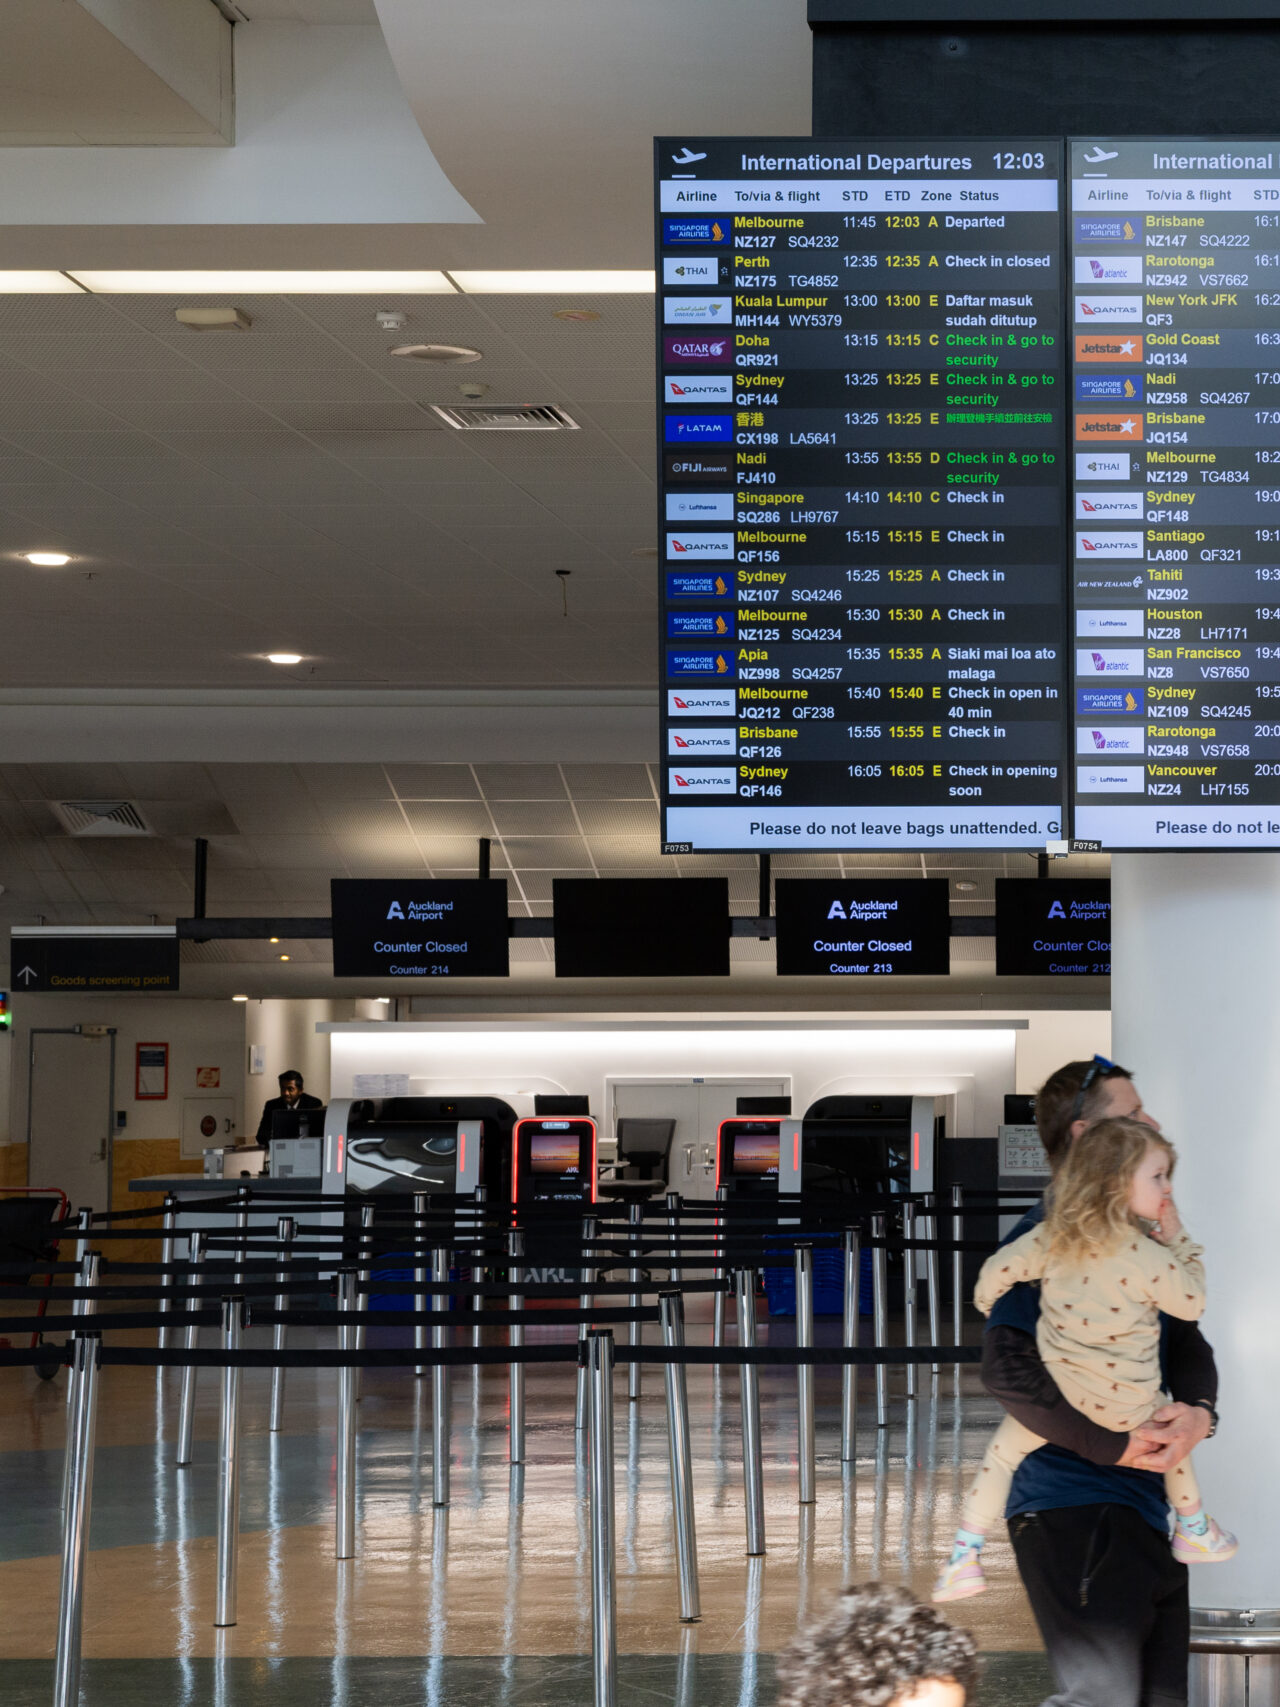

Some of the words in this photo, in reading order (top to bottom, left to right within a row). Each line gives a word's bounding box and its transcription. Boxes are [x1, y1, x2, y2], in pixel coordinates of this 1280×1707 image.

[742, 154, 861, 170] International
[868, 154, 972, 174] Departures
[993, 153, 1044, 169] 12:03
[1154, 154, 1272, 169] International
[677, 191, 717, 201] Airline
[735, 191, 770, 201] To/via
[775, 191, 784, 201] &
[788, 191, 820, 203] flight
[843, 191, 868, 201] STD
[885, 191, 910, 201] ETD
[921, 191, 952, 200] Zone
[960, 191, 999, 200] Status
[735, 217, 804, 227] Melbourne
[844, 216, 876, 227] 11:45
[886, 216, 919, 227] 12:03
[928, 216, 938, 227] A
[946, 216, 1004, 230] Departed
[735, 236, 776, 247] NZ127
[789, 236, 838, 247] SQ4232
[736, 335, 769, 346] Doha
[844, 334, 878, 346] 13:15
[886, 334, 920, 345] 13:15
[929, 334, 939, 345] C
[946, 334, 987, 345] Check
[992, 334, 1003, 345] in
[1007, 334, 1016, 345] &
[1021, 337, 1037, 348] go
[1042, 335, 1054, 345] to
[673, 344, 708, 353] QATAR
[736, 354, 778, 366] QR921
[946, 354, 998, 368] security
[736, 412, 764, 426] 香港
[845, 413, 878, 424] 13:25
[887, 413, 921, 424] 13:25
[931, 413, 939, 424] E
[736, 433, 778, 444] CX198
[790, 433, 835, 444] LA5641
[1147, 530, 1205, 544] Santiago
[1147, 550, 1188, 561] LA800
[1200, 549, 1240, 561] QF321
[1147, 569, 1182, 580] Tahiti
[1147, 589, 1188, 600] NZ902
[751, 822, 801, 834] Please
[807, 822, 826, 834] do
[832, 823, 856, 834] not
[862, 822, 901, 834] leave
[907, 822, 944, 837] bags
[950, 821, 1041, 834] unattended.
[1047, 821, 1062, 833] G
[1073, 842, 1098, 850] F0754
[408, 901, 453, 911] Auckland
[1070, 901, 1111, 909] Aucklan
[408, 911, 442, 921] Airport
[1070, 910, 1106, 920] Airport
[374, 942, 422, 952] Counter
[426, 941, 467, 952] Closed
[1033, 940, 1083, 951] Counter
[390, 965, 427, 974] Counter
[432, 966, 448, 974] 214
[1049, 963, 1088, 972] Counter
[1093, 964, 1111, 972] 212
[51, 976, 86, 985] Goods
[89, 976, 140, 986] screening
[144, 976, 169, 986] point
